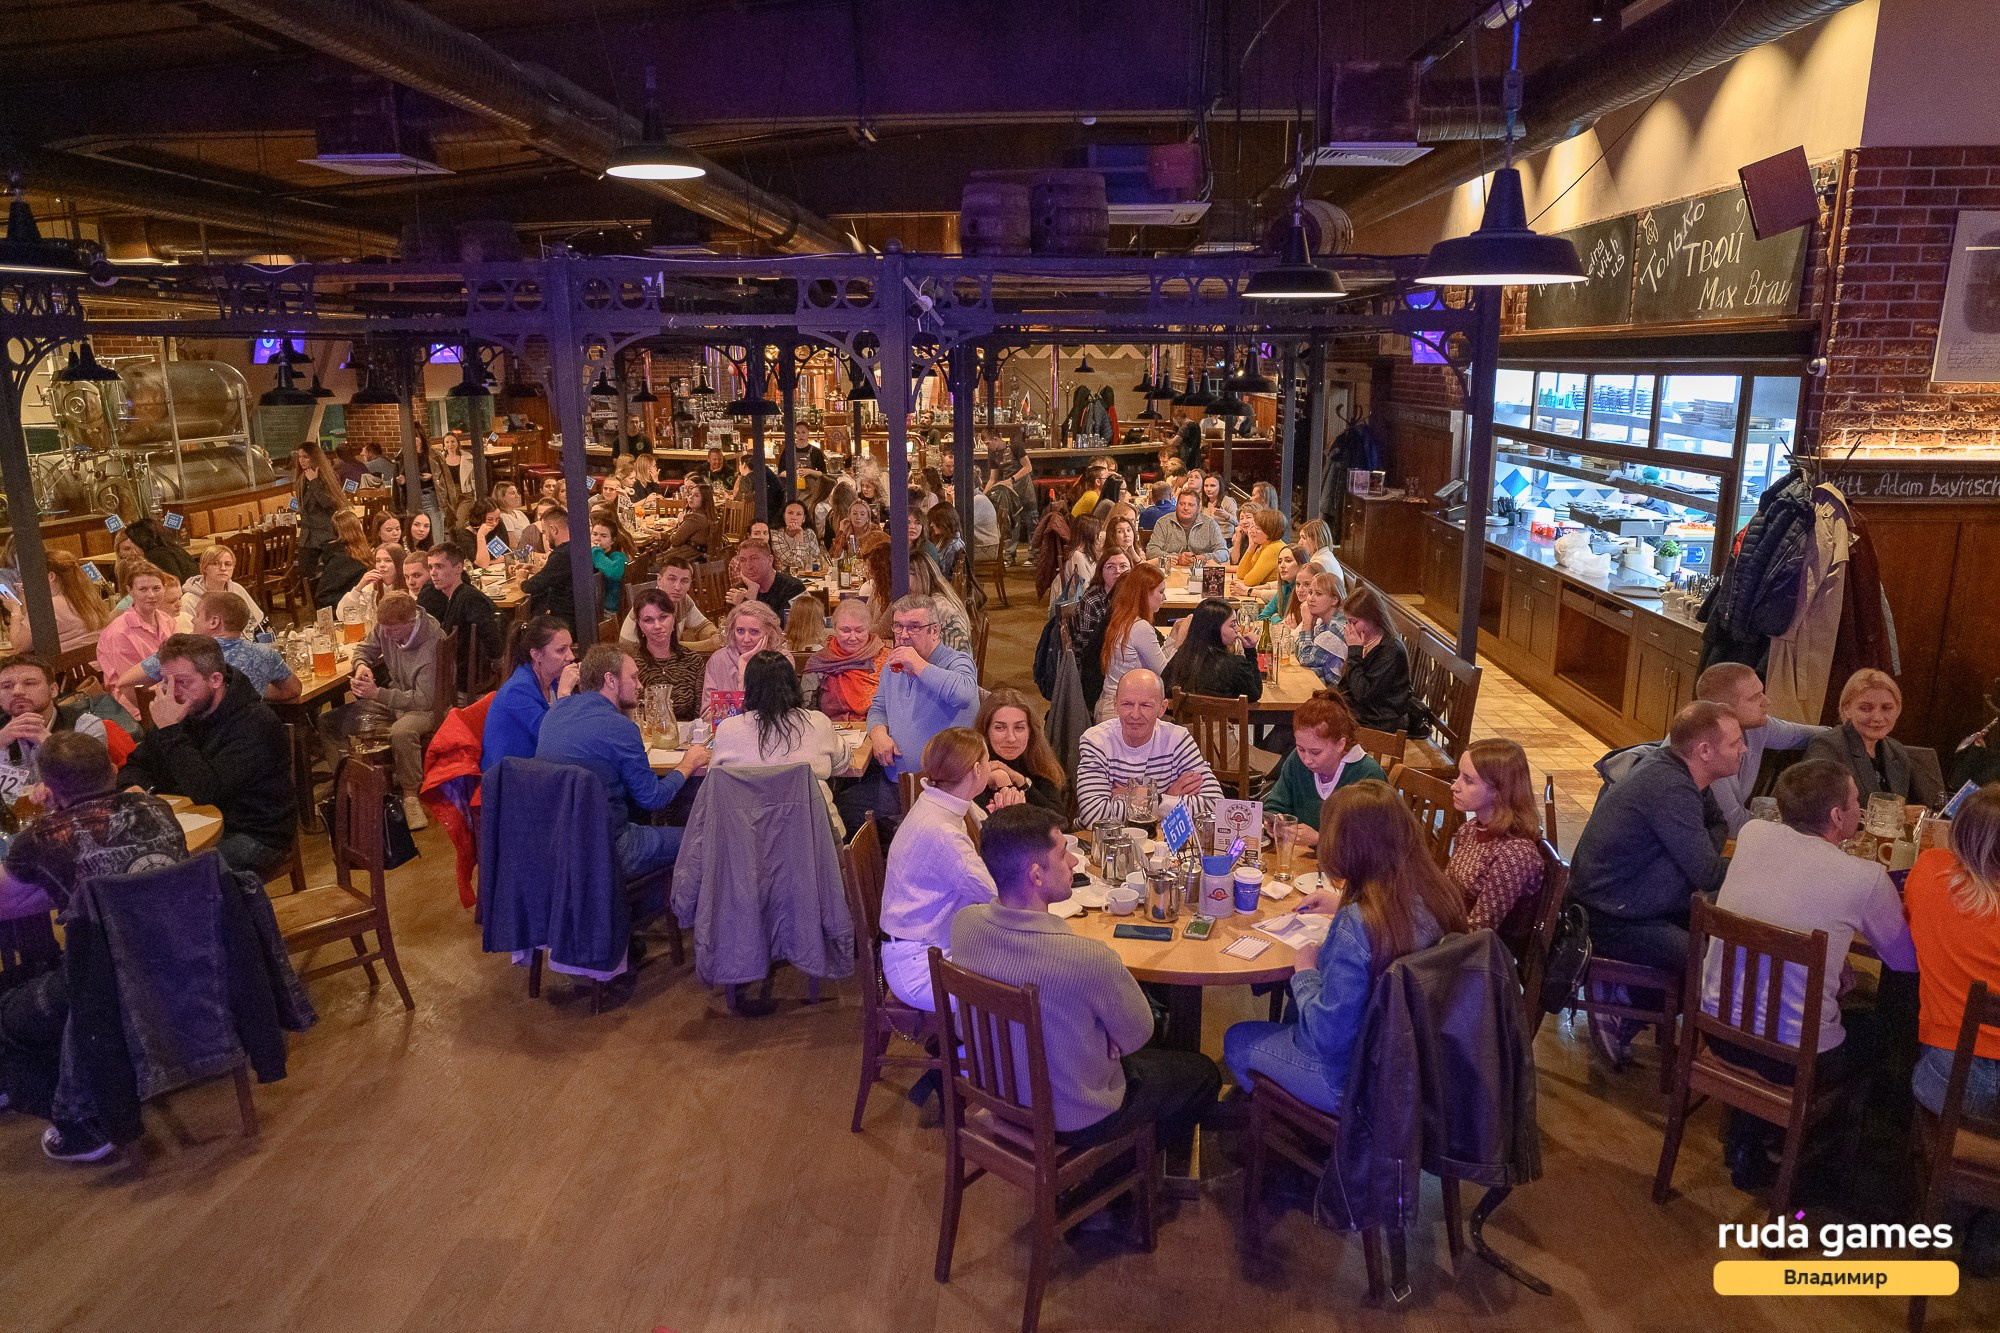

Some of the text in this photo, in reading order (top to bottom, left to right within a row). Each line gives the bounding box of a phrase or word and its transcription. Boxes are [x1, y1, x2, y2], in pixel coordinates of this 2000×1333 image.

[1697, 269, 1793, 310] Max Brau
[1874, 473, 1923, 496] Adam
[1170, 819, 1186, 844] 510
